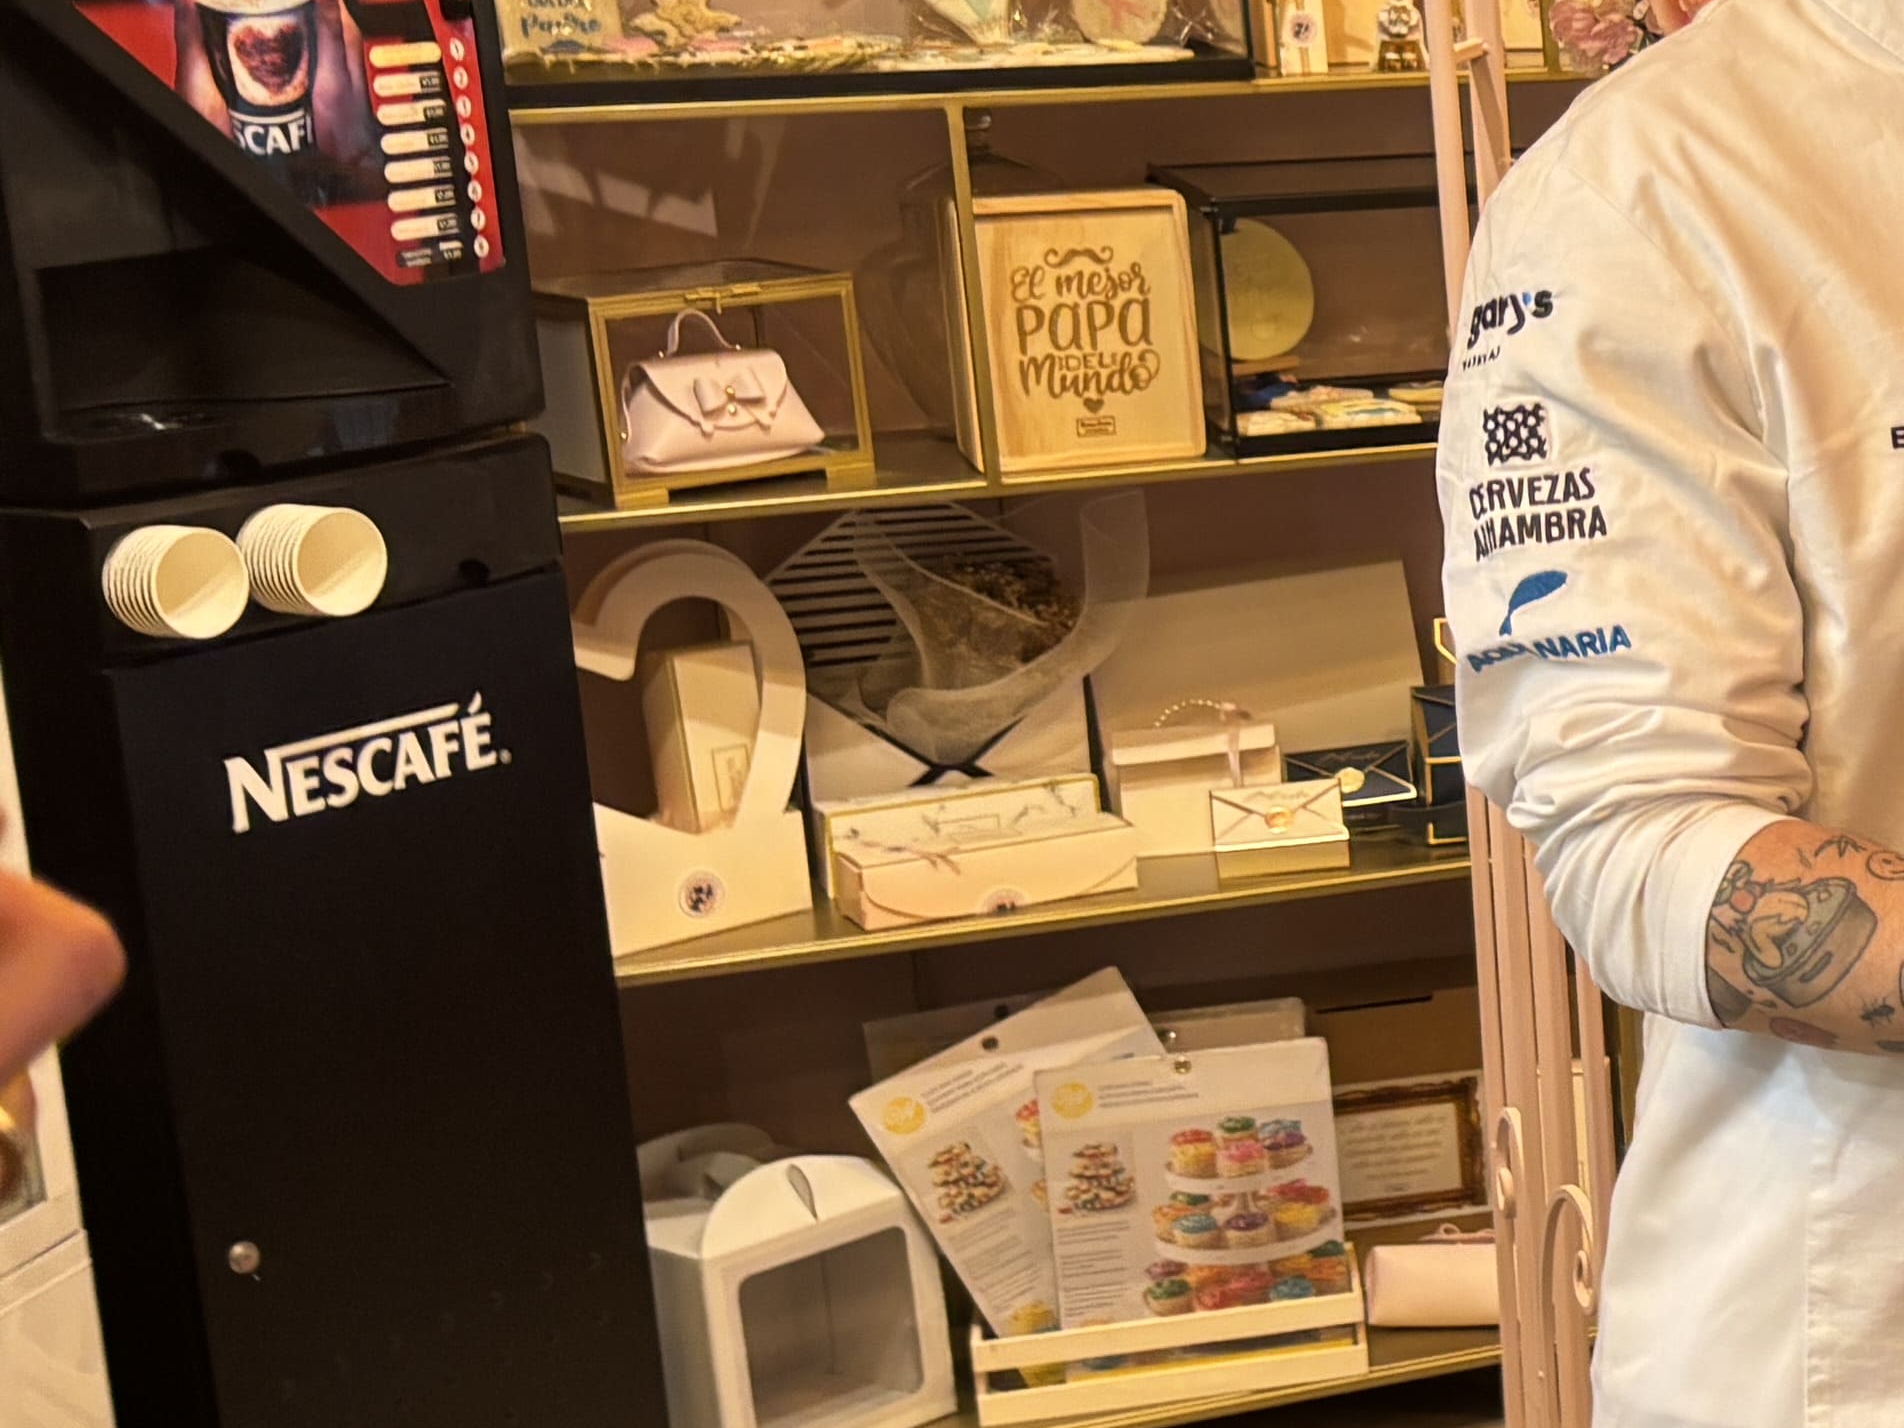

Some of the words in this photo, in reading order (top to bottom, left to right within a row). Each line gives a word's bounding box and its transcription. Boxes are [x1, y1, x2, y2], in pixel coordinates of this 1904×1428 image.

[1010, 264, 1046, 304] El
[1055, 261, 1151, 302] mejor
[1469, 466, 1597, 520] CERVEZAS
[223, 690, 498, 835] NESCAFÉ
